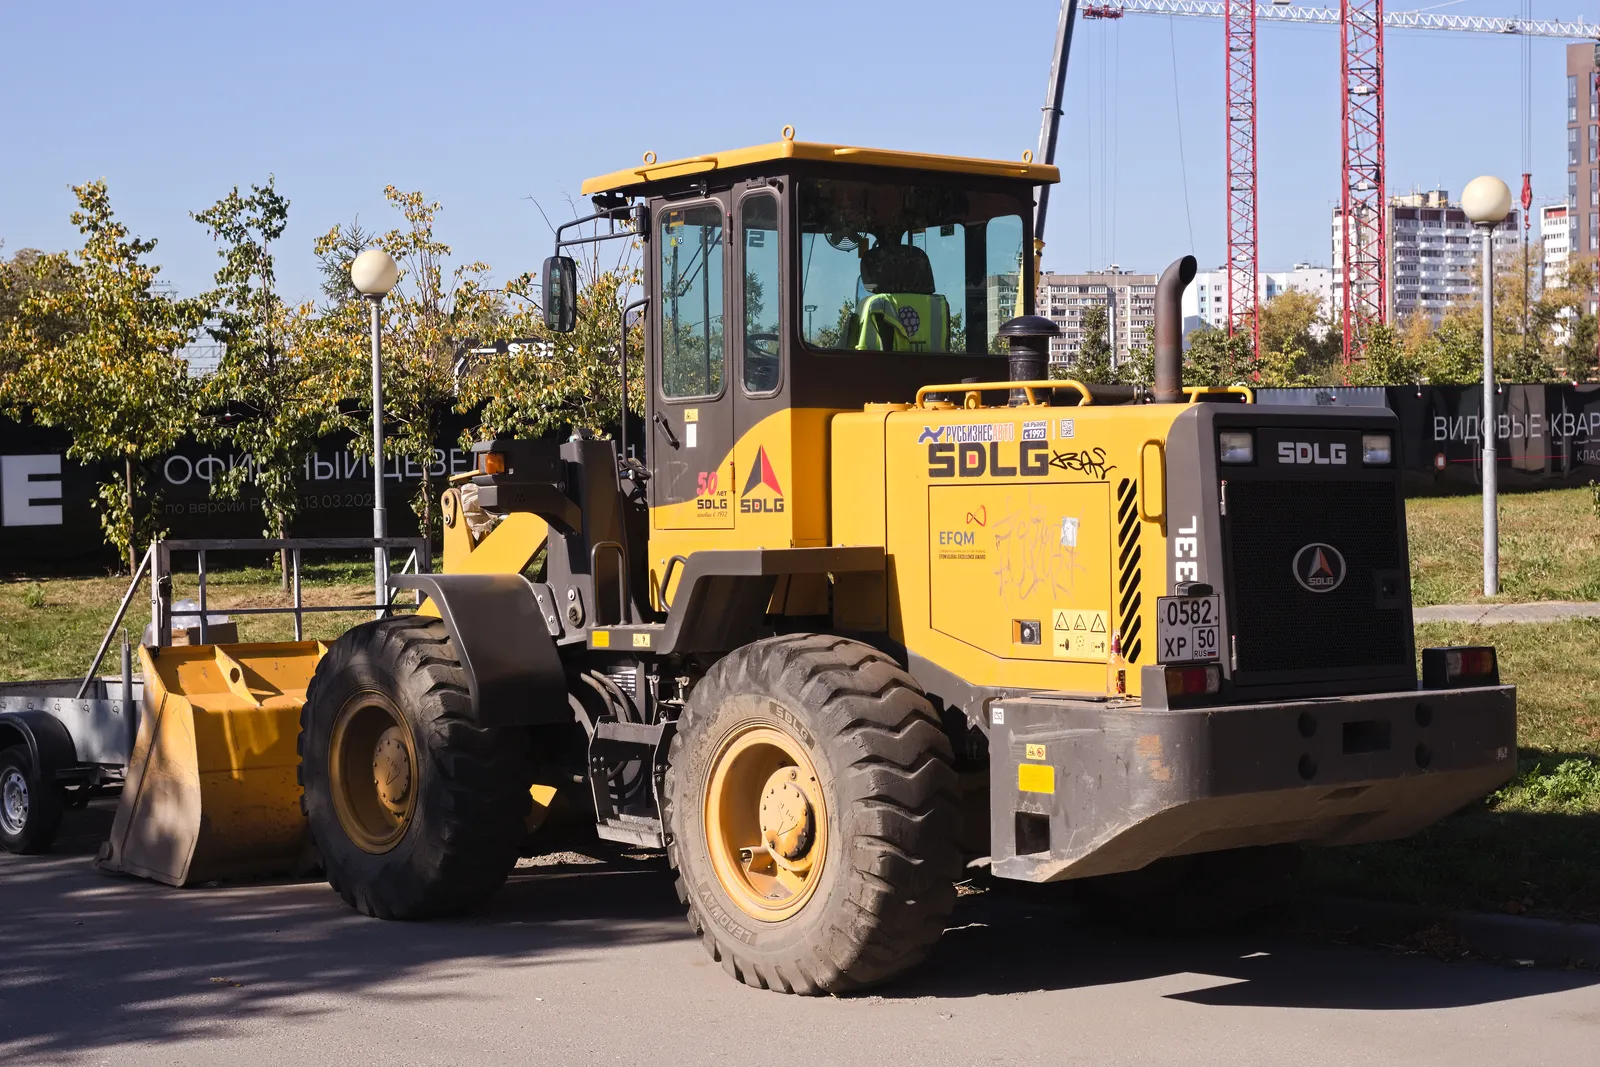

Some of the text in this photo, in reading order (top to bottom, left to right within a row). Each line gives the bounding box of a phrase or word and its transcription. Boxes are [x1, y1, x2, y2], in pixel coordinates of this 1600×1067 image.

[946, 423, 1014, 442] РУСБИЗНЕСАВТО
[928, 441, 1049, 477] SDLG
[1277, 441, 1347, 465] SDLG
[696, 471, 718, 496] 50
[165, 503, 185, 515] по
[189, 501, 245, 518] версии
[303, 493, 375, 509] 13.03.202
[697, 499, 728, 509] SDLG
[740, 498, 784, 513] SDLG
[939, 531, 975, 546] EFQM
[1308, 577, 1334, 586] SDLG
[1167, 599, 1212, 626] 0582
[1197, 629, 1215, 648] 50
[1194, 650, 1207, 658] RUS
[775, 705, 809, 740] SDLG
